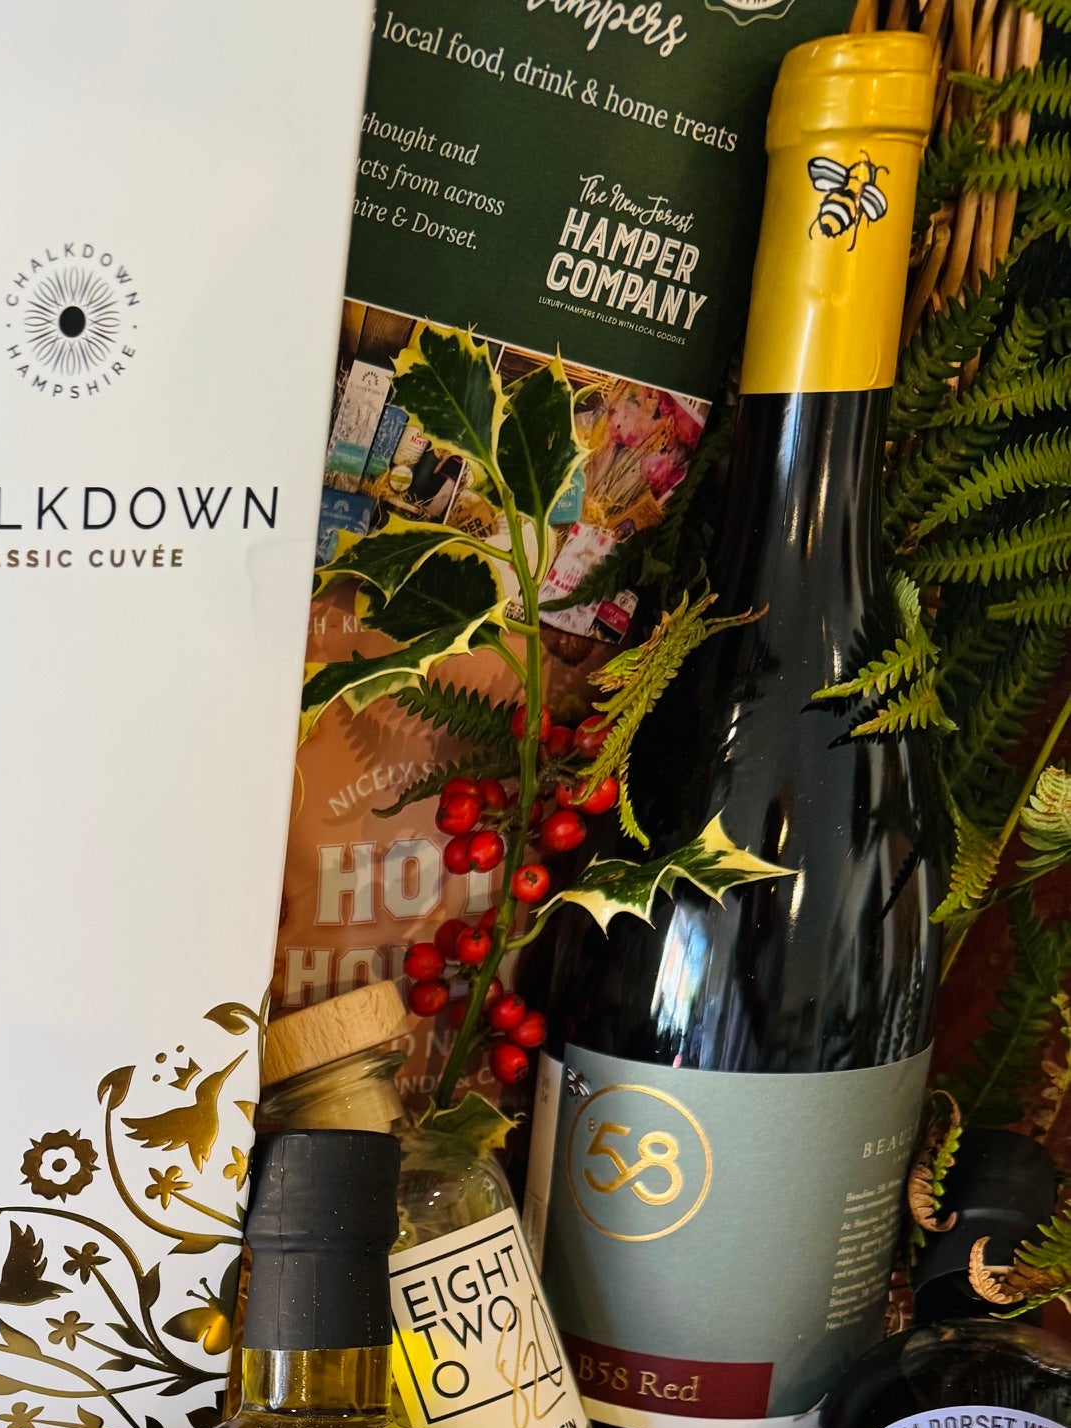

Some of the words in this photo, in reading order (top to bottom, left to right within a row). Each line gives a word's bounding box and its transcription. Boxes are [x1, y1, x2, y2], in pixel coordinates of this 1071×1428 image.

[382, 11, 440, 56] local
[447, 32, 506, 81] food,
[513, 56, 578, 99] drink
[580, 79, 599, 107] &
[602, 84, 669, 129] home
[675, 111, 738, 153] treats
[360, 112, 438, 152] thought
[439, 144, 480, 166] and
[387, 163, 439, 197] from
[444, 184, 505, 216] across
[579, 174, 608, 204] The
[609, 183, 644, 217] New
[639, 194, 695, 234] Forest
[391, 206, 408, 227] &
[411, 212, 478, 250] Dorset.
[558, 207, 701, 285] HAMPER
[5, 241, 141, 308] CHALKDOWN
[546, 251, 708, 331] COMPANY
[539, 295, 564, 309] LUXURY
[565, 303, 596, 319] HAMPERS
[596, 312, 618, 325] FILLED
[618, 319, 635, 331] WITH
[635, 324, 655, 337] LOCAL
[656, 331, 686, 346] GOODIES
[6, 343, 137, 400] HAMPSHIRE
[88, 543, 185, 568] CUVÉE
[328, 761, 415, 817] NICELY
[401, 1244, 519, 1323] EIGHT
[413, 1295, 517, 1361] TWO
[432, 1360, 470, 1398] O
[578, 1355, 628, 1392] B58
[637, 1370, 699, 1403] Red
